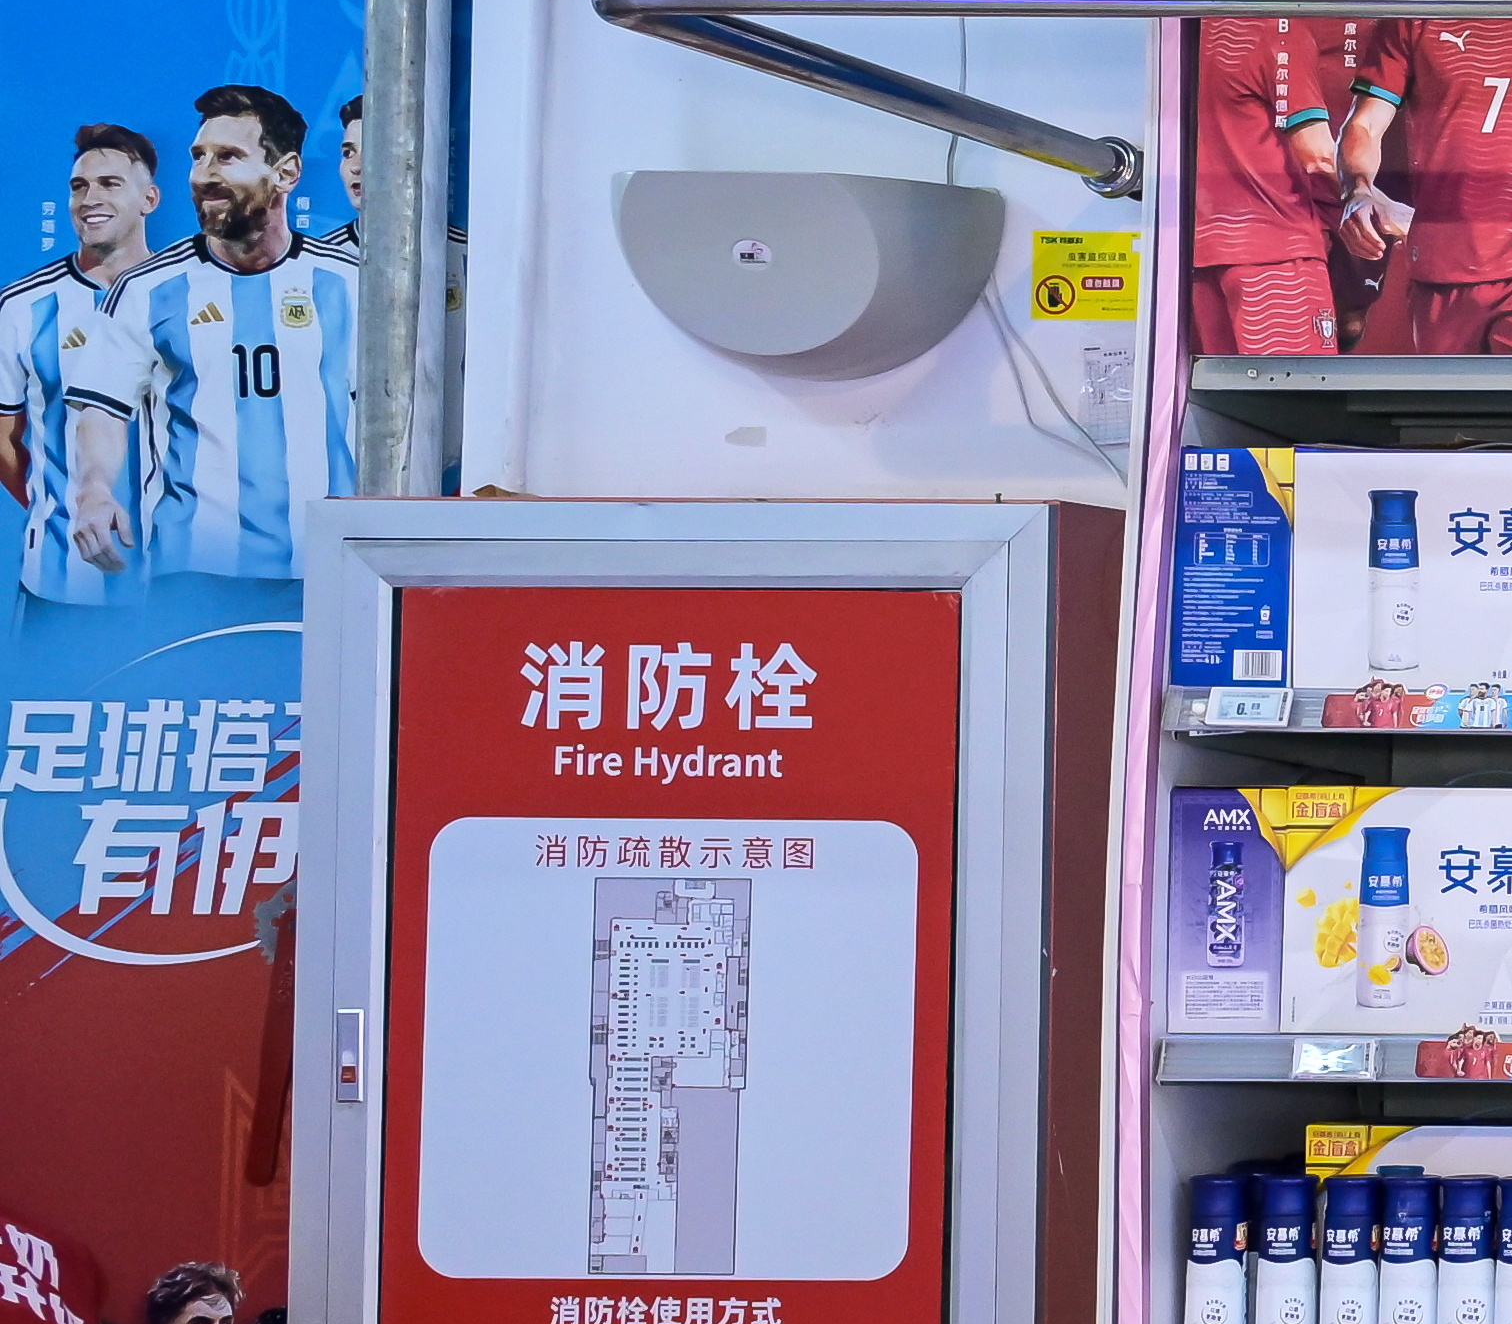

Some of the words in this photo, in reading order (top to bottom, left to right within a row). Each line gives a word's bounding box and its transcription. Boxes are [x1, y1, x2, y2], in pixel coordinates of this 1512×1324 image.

[1480, 77, 1510, 133] 7
[232, 345, 280, 400] 10
[519, 641, 818, 732] 消防栓
[553, 746, 623, 777] Fire
[633, 746, 783, 785] Hydrant
[535, 834, 817, 870] 消防疏散示意图
